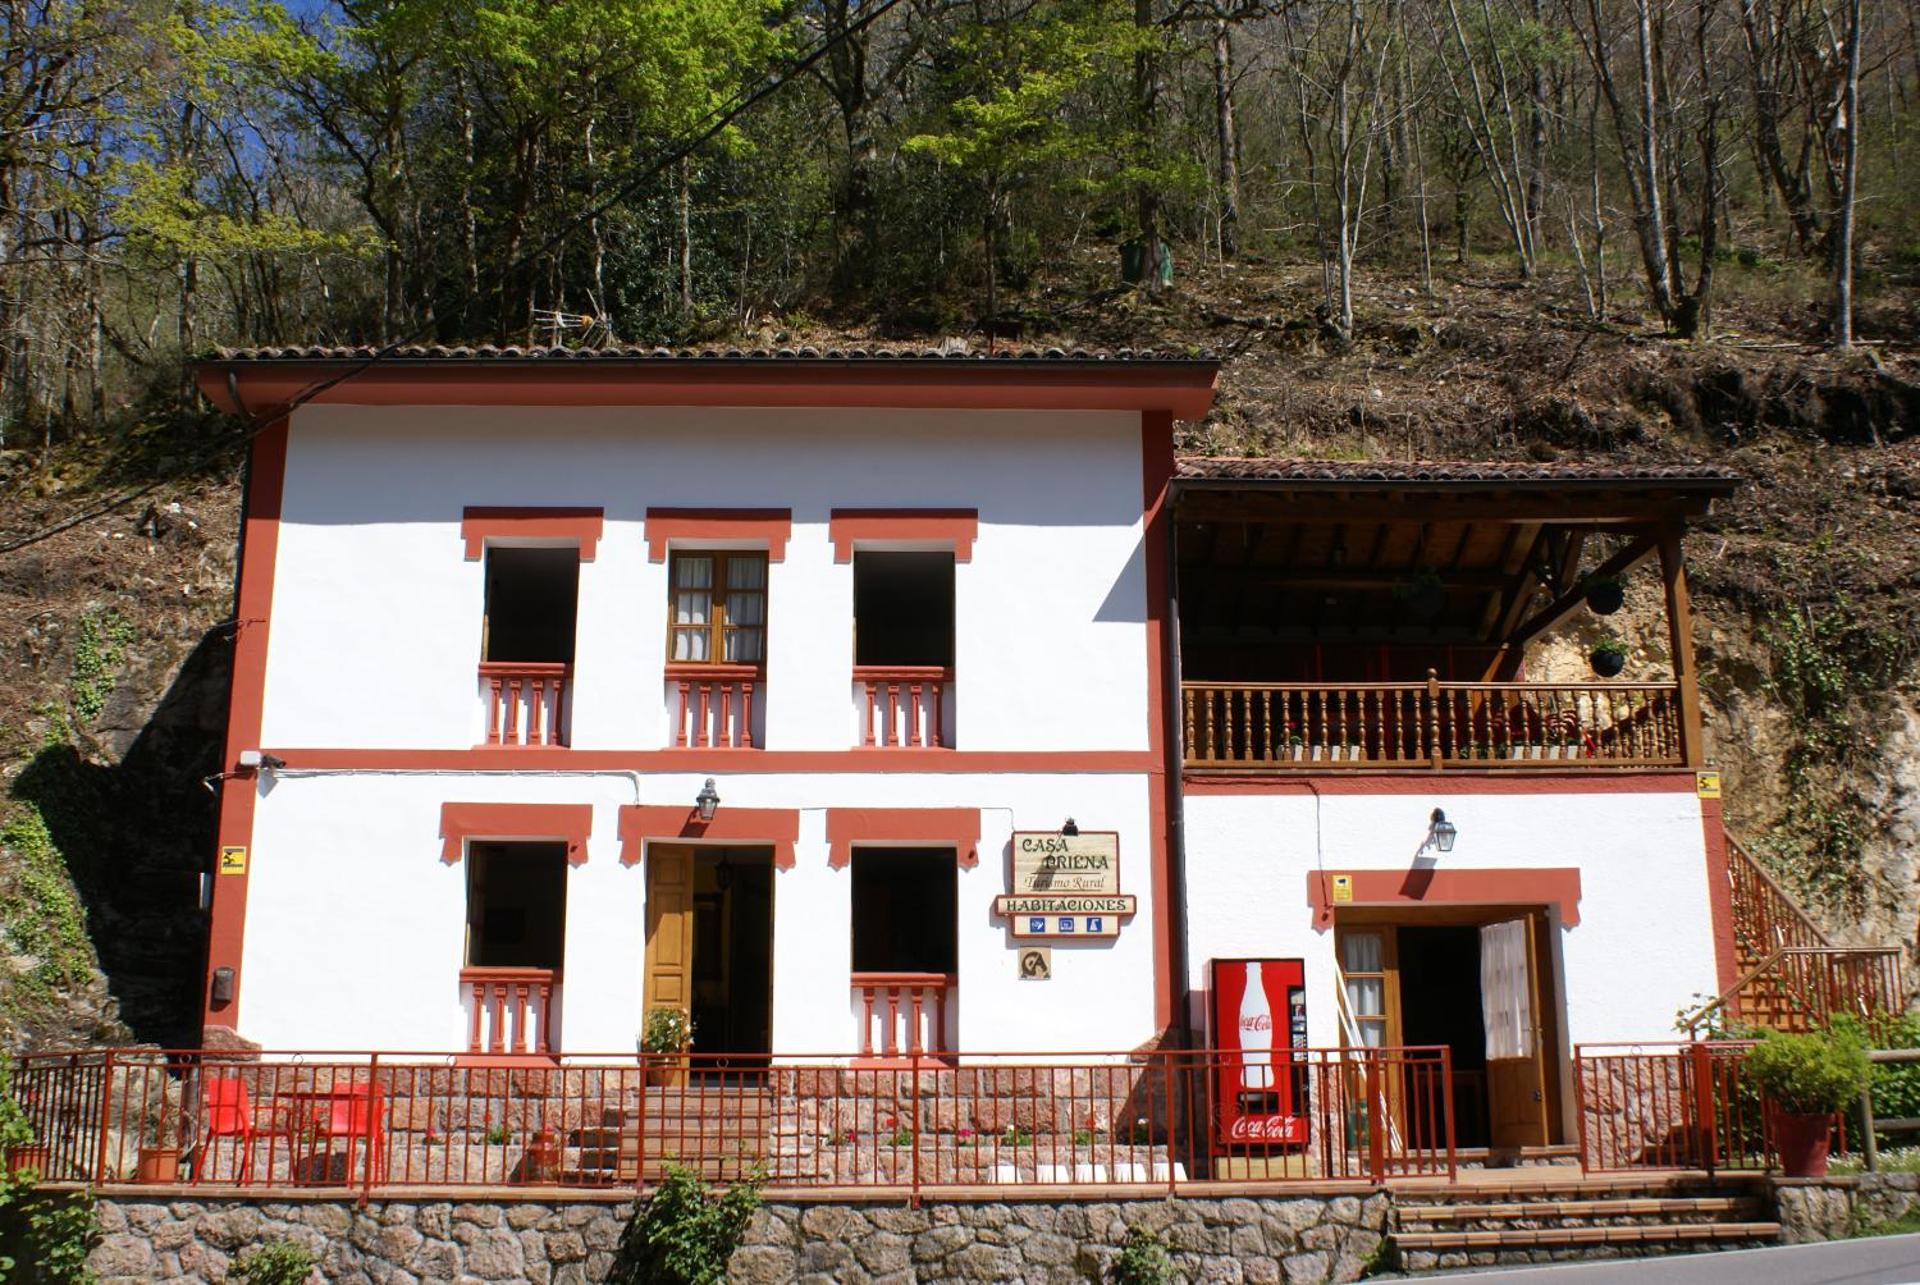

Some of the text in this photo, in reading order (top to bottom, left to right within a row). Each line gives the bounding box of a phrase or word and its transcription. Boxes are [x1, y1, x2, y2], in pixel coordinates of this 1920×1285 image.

[1022, 838, 1069, 852] CASA
[1043, 854, 1109, 870] PRIENA
[1073, 876, 1105, 890] Rural
[1006, 899, 1127, 912] HABITACIONES
